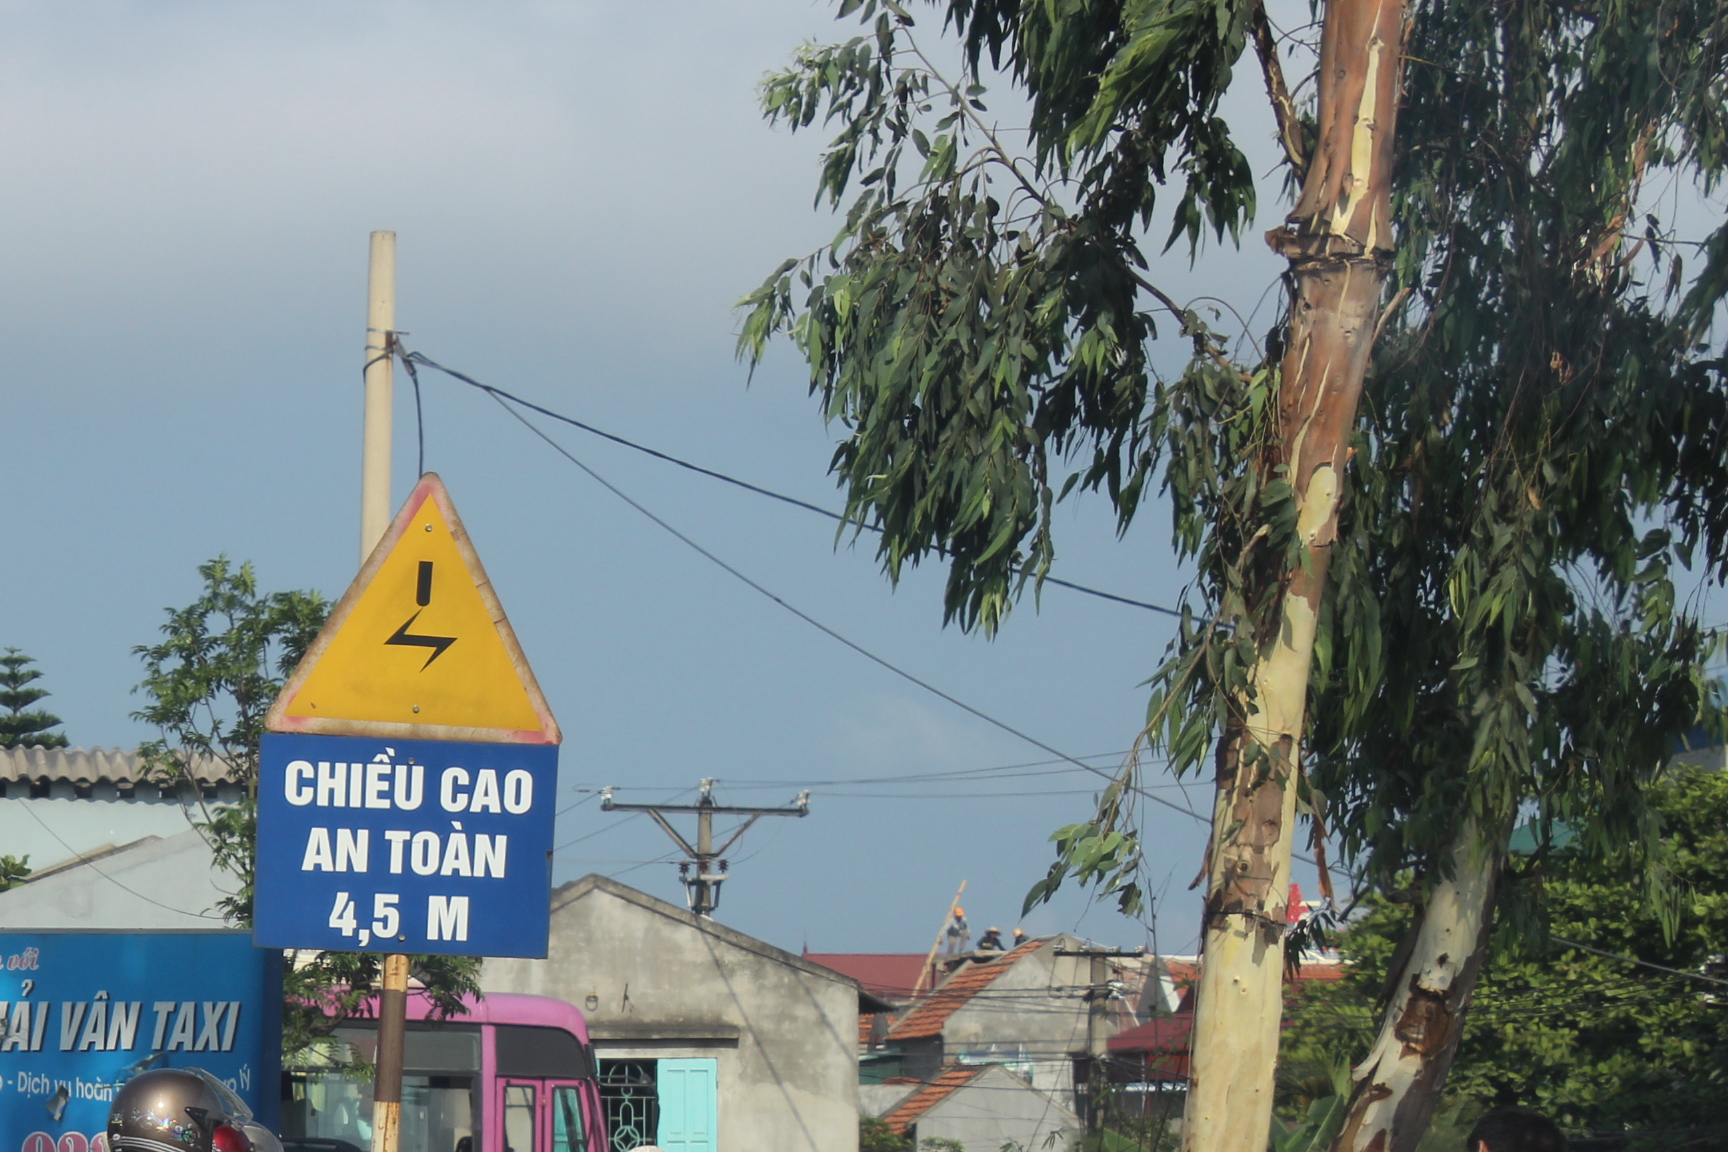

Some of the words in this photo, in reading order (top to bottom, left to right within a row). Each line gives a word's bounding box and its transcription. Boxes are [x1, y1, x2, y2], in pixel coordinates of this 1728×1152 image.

[285, 747, 424, 810] CHIỀU
[440, 767, 533, 814] CAO
[301, 827, 369, 872] AN
[384, 821, 507, 878] TOÀN
[329, 892, 400, 947] 4,5
[427, 896, 469, 941] M
[7, 947, 40, 970] với
[59, 991, 142, 1052] VÂN
[151, 1002, 241, 1052] TAXI
[18, 1071, 50, 1098] Dịch
[76, 1076, 113, 1102] hoàn
